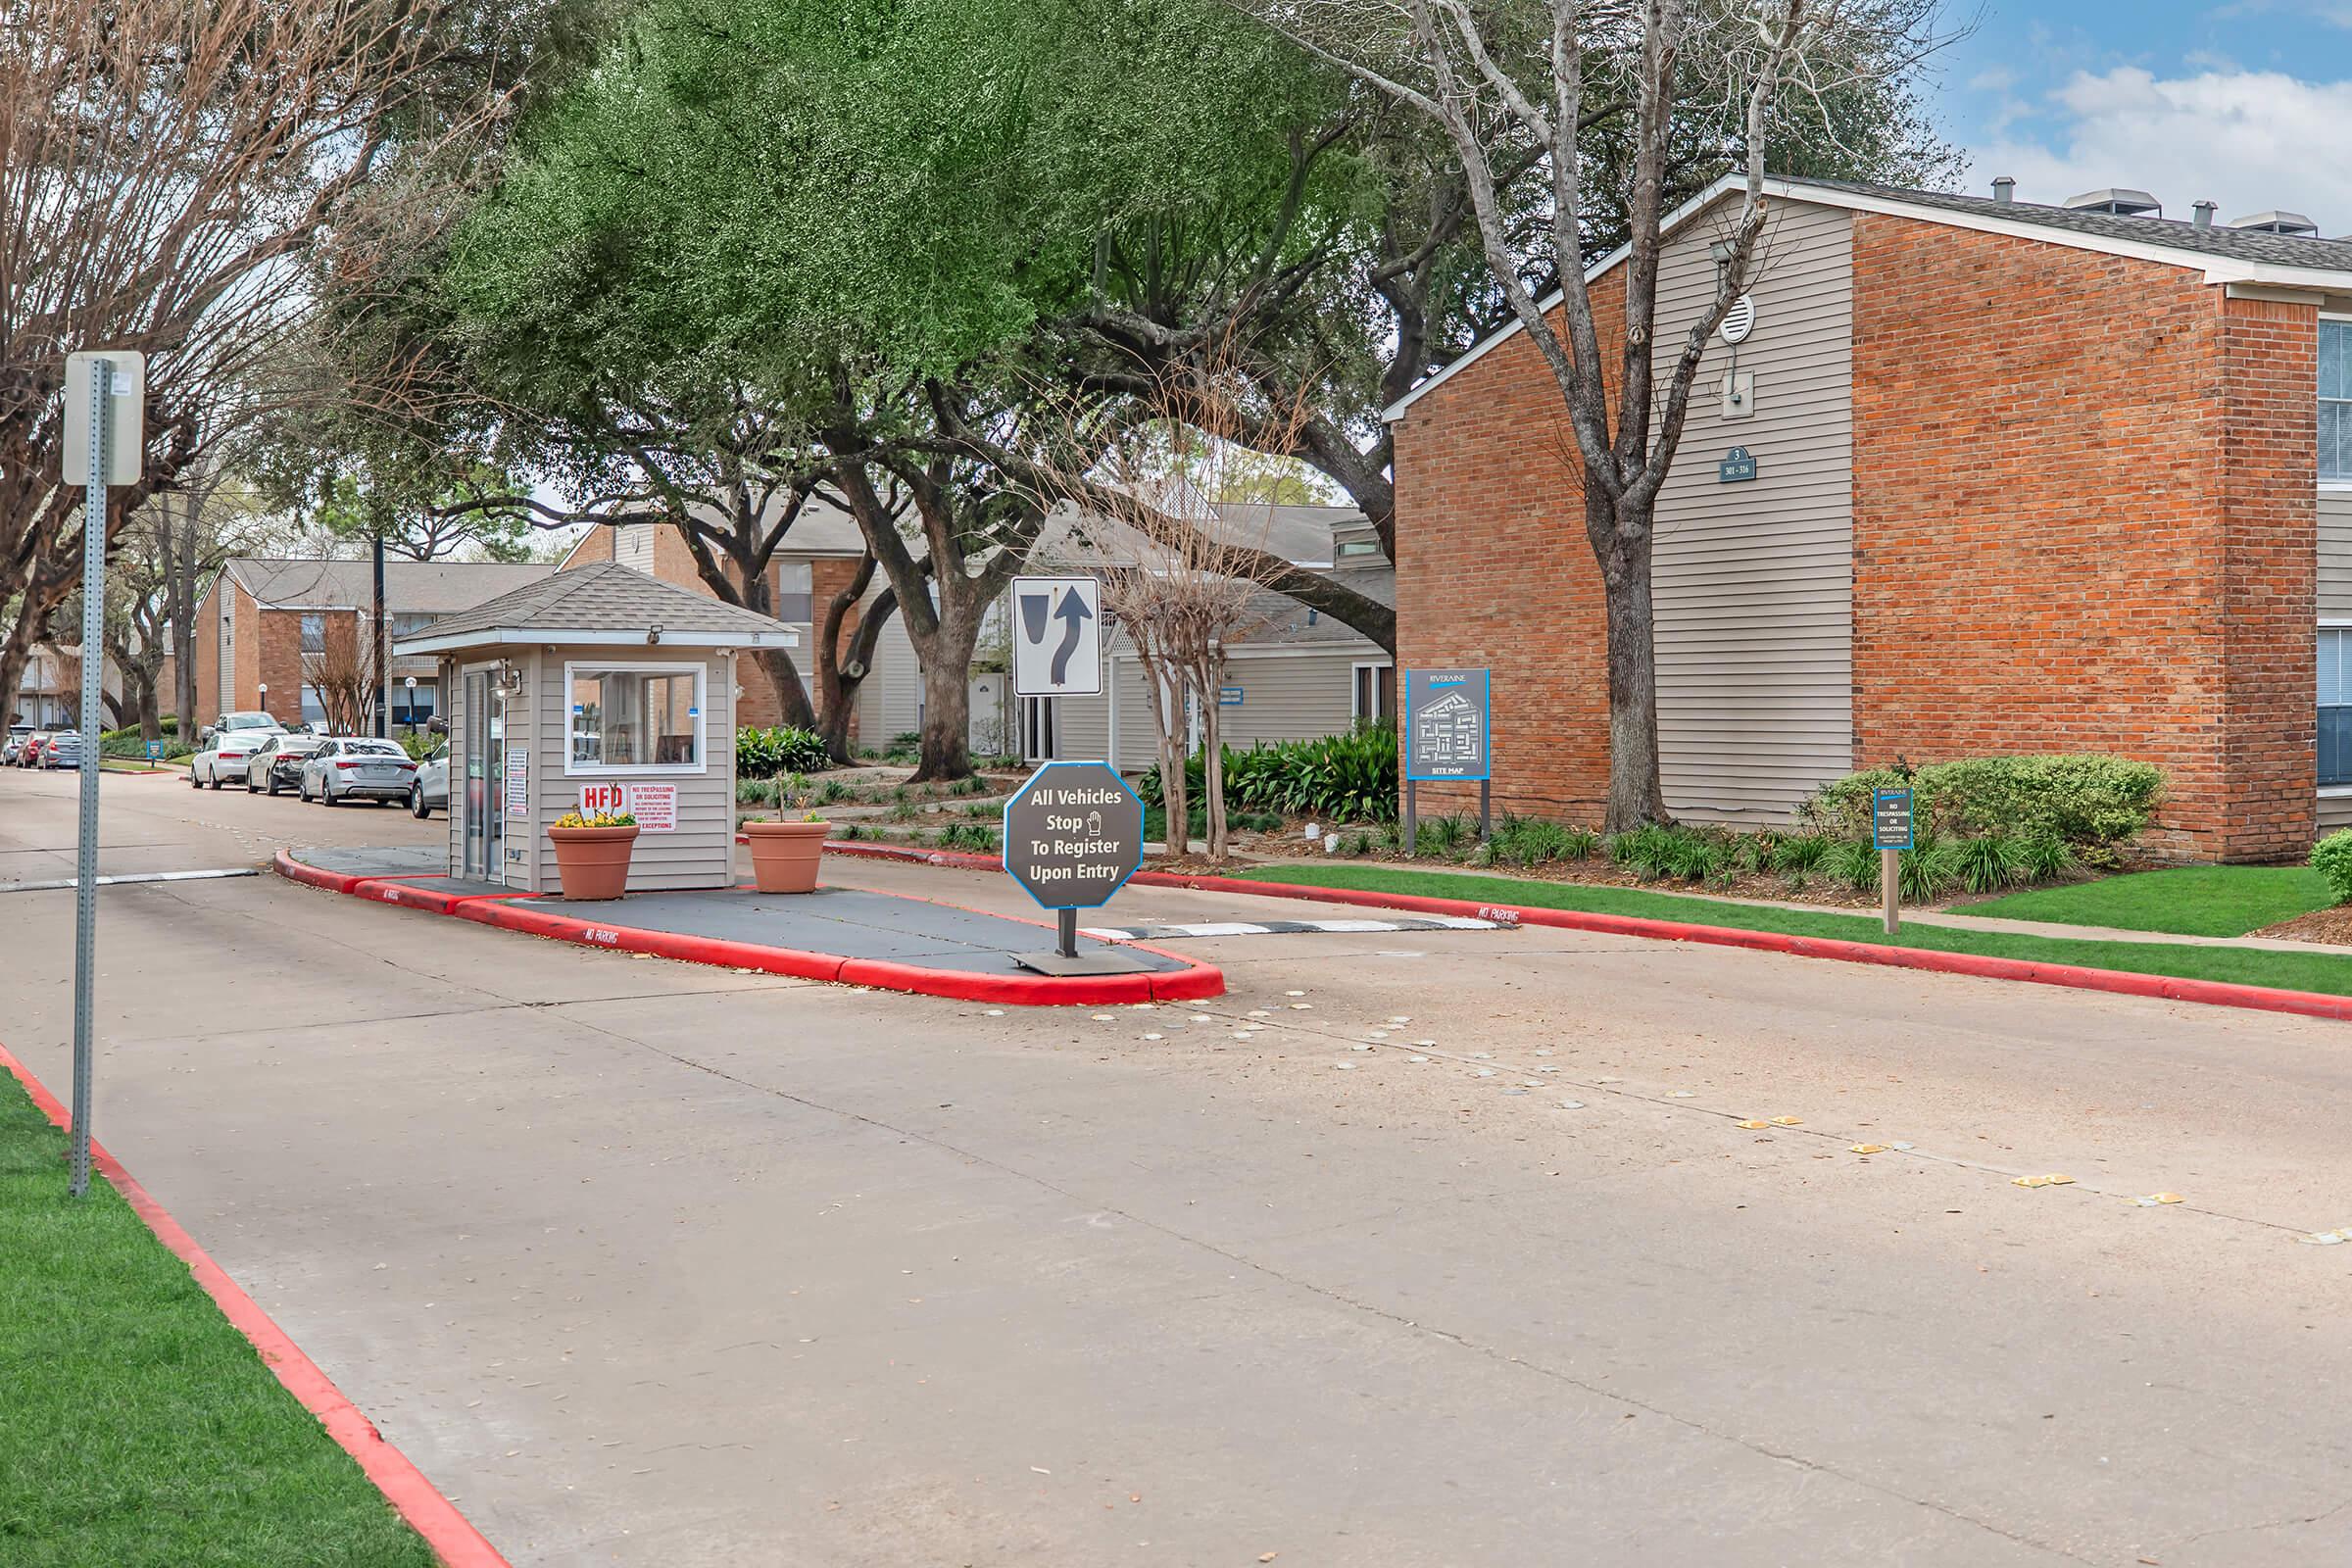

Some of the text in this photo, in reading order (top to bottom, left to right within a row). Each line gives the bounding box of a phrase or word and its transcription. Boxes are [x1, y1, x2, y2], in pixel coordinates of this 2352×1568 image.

[1735, 450, 1740, 460] 3
[585, 787, 622, 808] HFD
[1031, 788, 1122, 806] All Vehicles
[1047, 815, 1082, 833] Stop
[1031, 838, 1120, 858] To Register
[1030, 863, 1119, 884] Upon Entry
[1479, 907, 1519, 921] NO PARKING
[586, 929, 618, 943] NO PARKING
